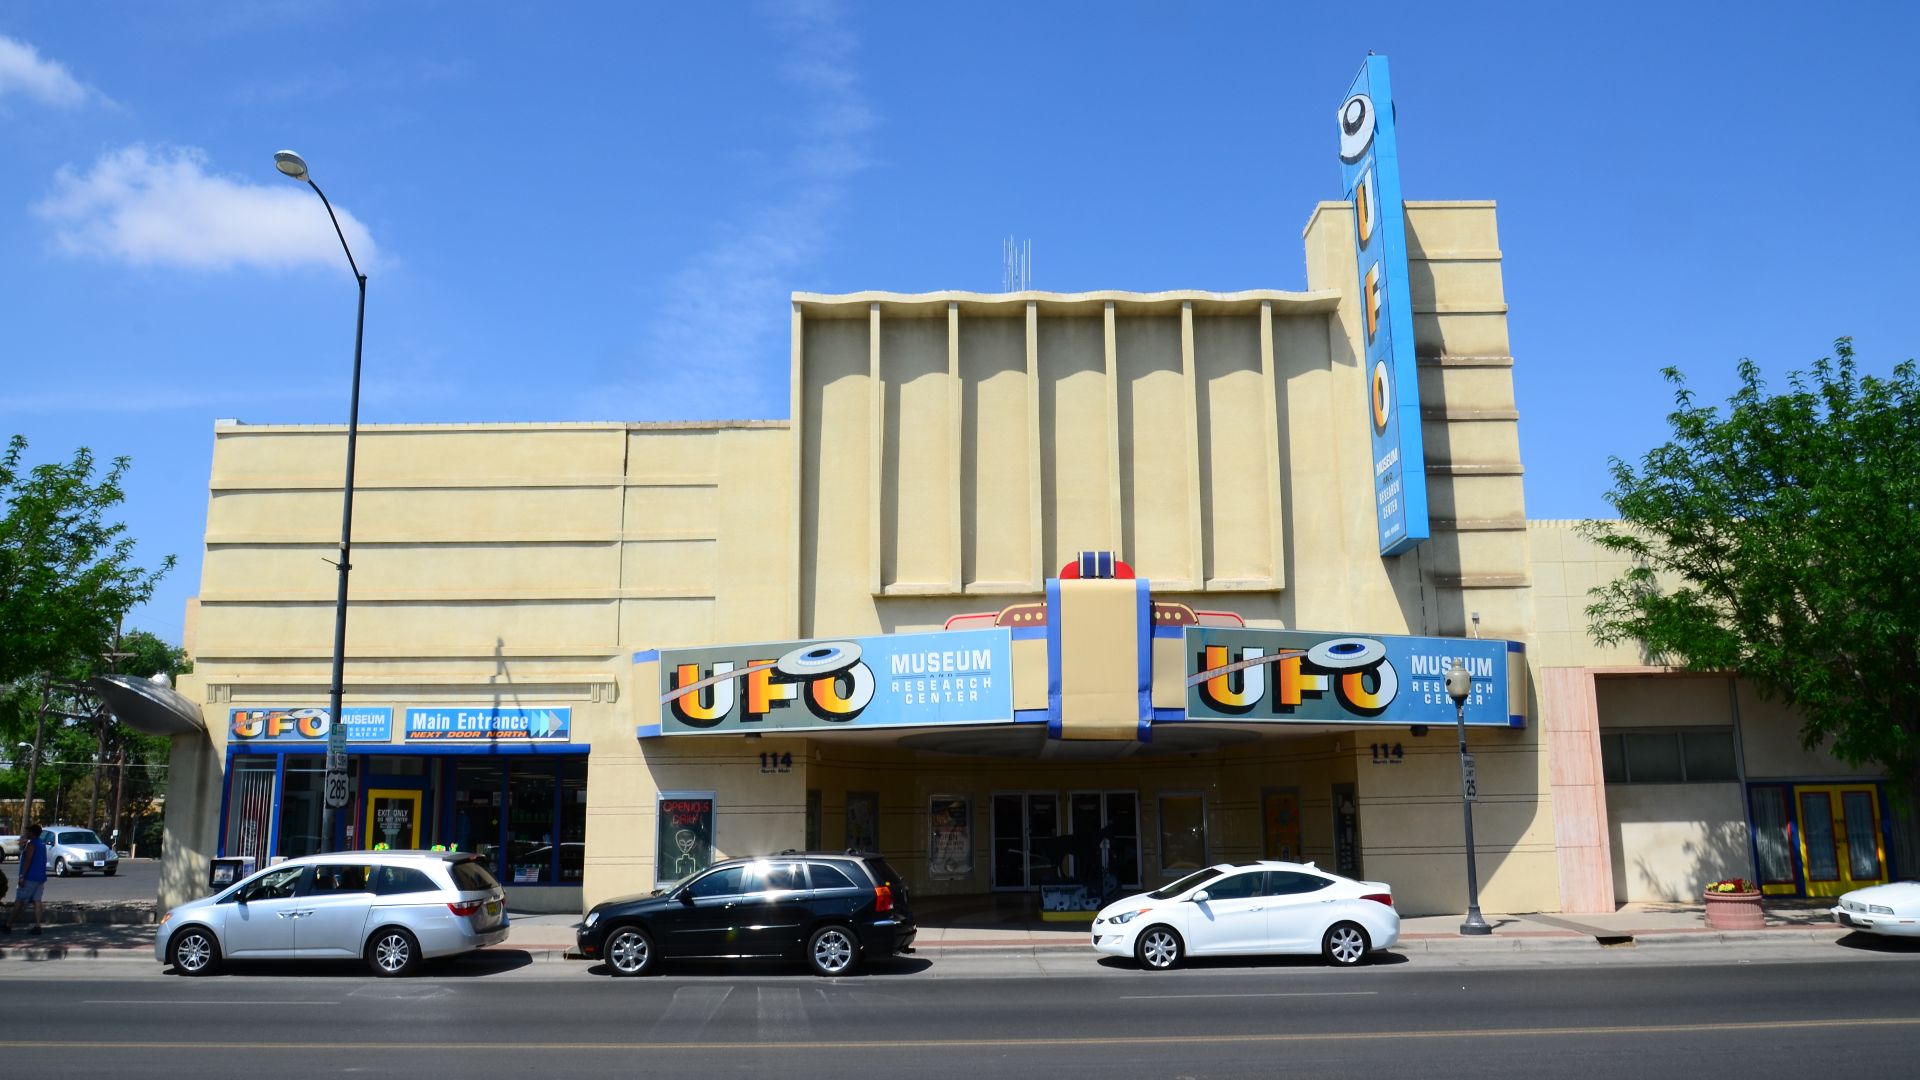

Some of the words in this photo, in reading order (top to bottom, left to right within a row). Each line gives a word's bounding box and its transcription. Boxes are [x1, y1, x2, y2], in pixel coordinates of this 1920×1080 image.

[1376, 447, 1399, 477] MUSEUM
[891, 649, 991, 674] MUSEUM
[891, 677, 992, 693] RESEARCH
[1198, 645, 1399, 717] UFO
[1412, 681, 1493, 693] RESCH
[670, 659, 876, 727] UFO
[905, 690, 978, 705] CENTER
[1424, 693, 1483, 705] CENER
[233, 710, 331, 738] UFO
[413, 713, 450, 730] Main
[457, 712, 529, 730] Entrance
[1370, 743, 1404, 759] 114
[760, 752, 793, 768] 114
[330, 779, 346, 800] 285
[1466, 779, 1476, 796] 25
[377, 809, 390, 817] EXIT
[393, 809, 408, 817] ONLY
